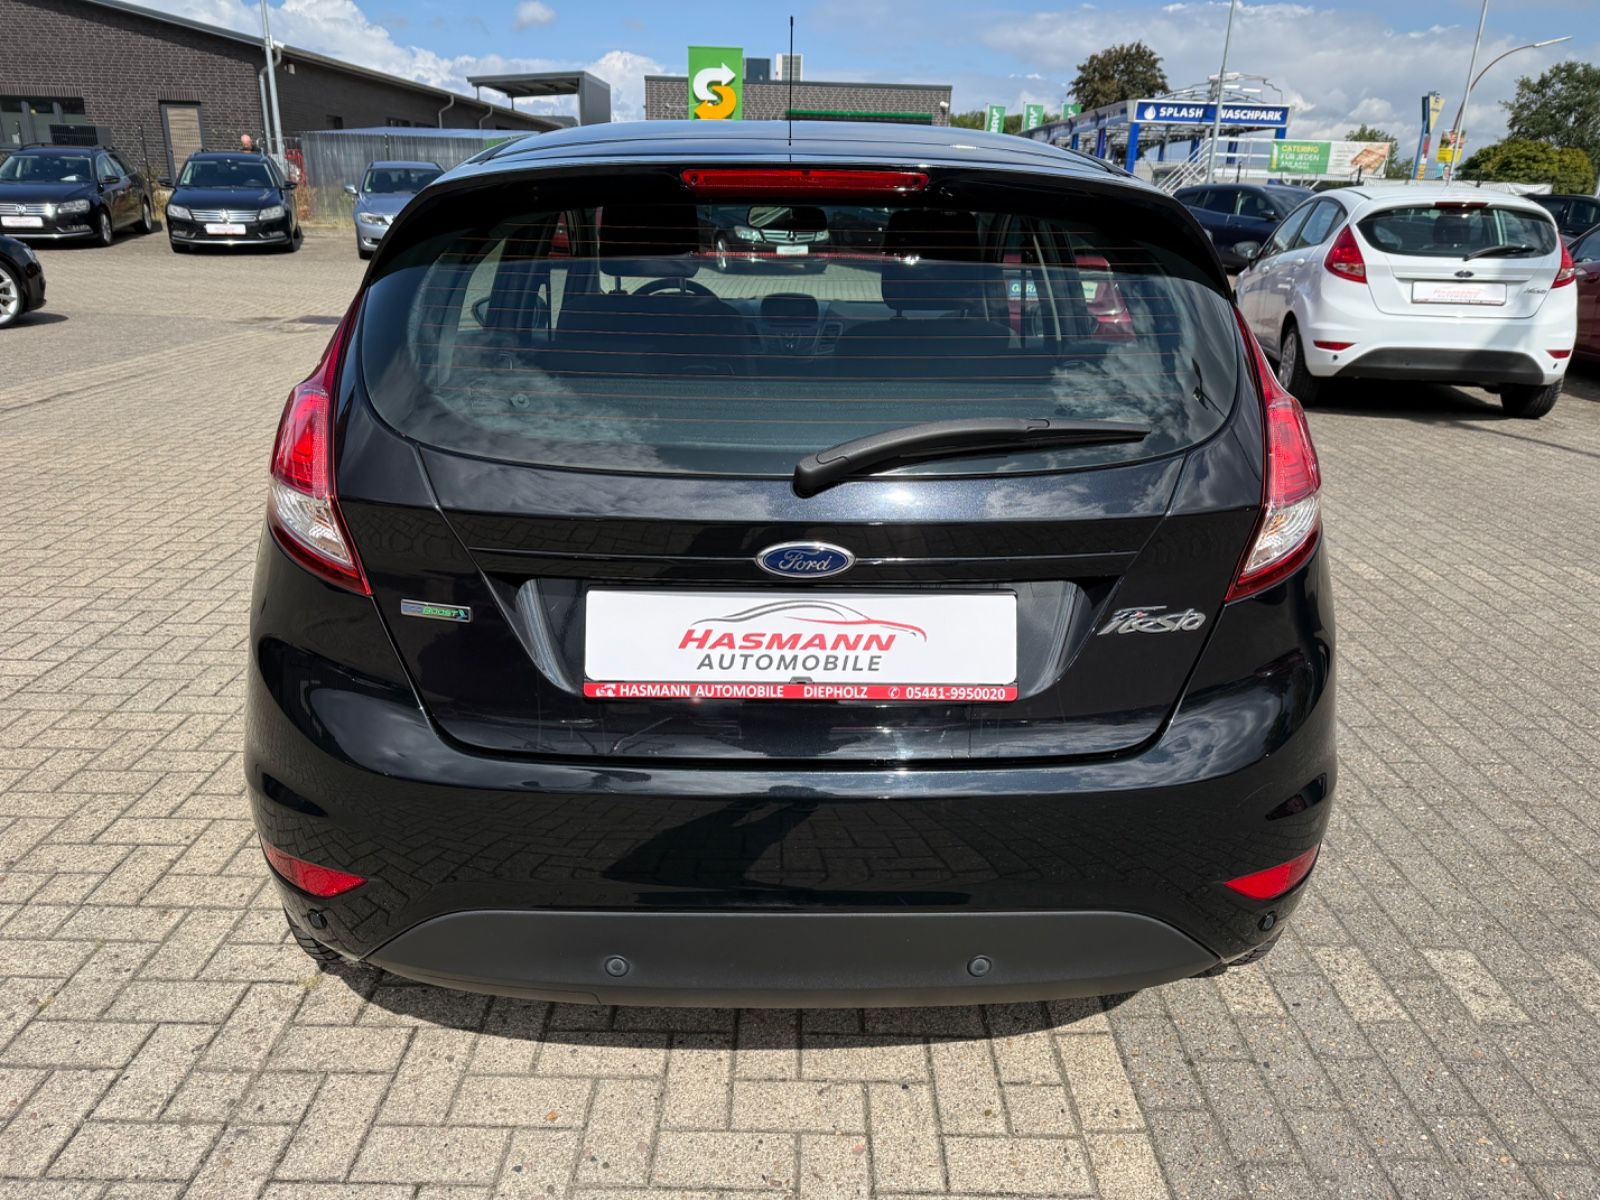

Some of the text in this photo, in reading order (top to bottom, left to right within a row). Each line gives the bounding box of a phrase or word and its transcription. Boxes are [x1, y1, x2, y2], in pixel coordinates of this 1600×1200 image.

[1159, 106, 1204, 118] SPLASH
[1281, 145, 1320, 154] CATERING
[778, 549, 833, 571] Ford
[1097, 605, 1207, 636] Fiesta
[678, 628, 897, 651] HASMANN
[696, 653, 883, 672] AUTOMOBILE
[619, 684, 1006, 700] HASMANN AUTOMOBILE DIEPHOLZ 05441-9950020
